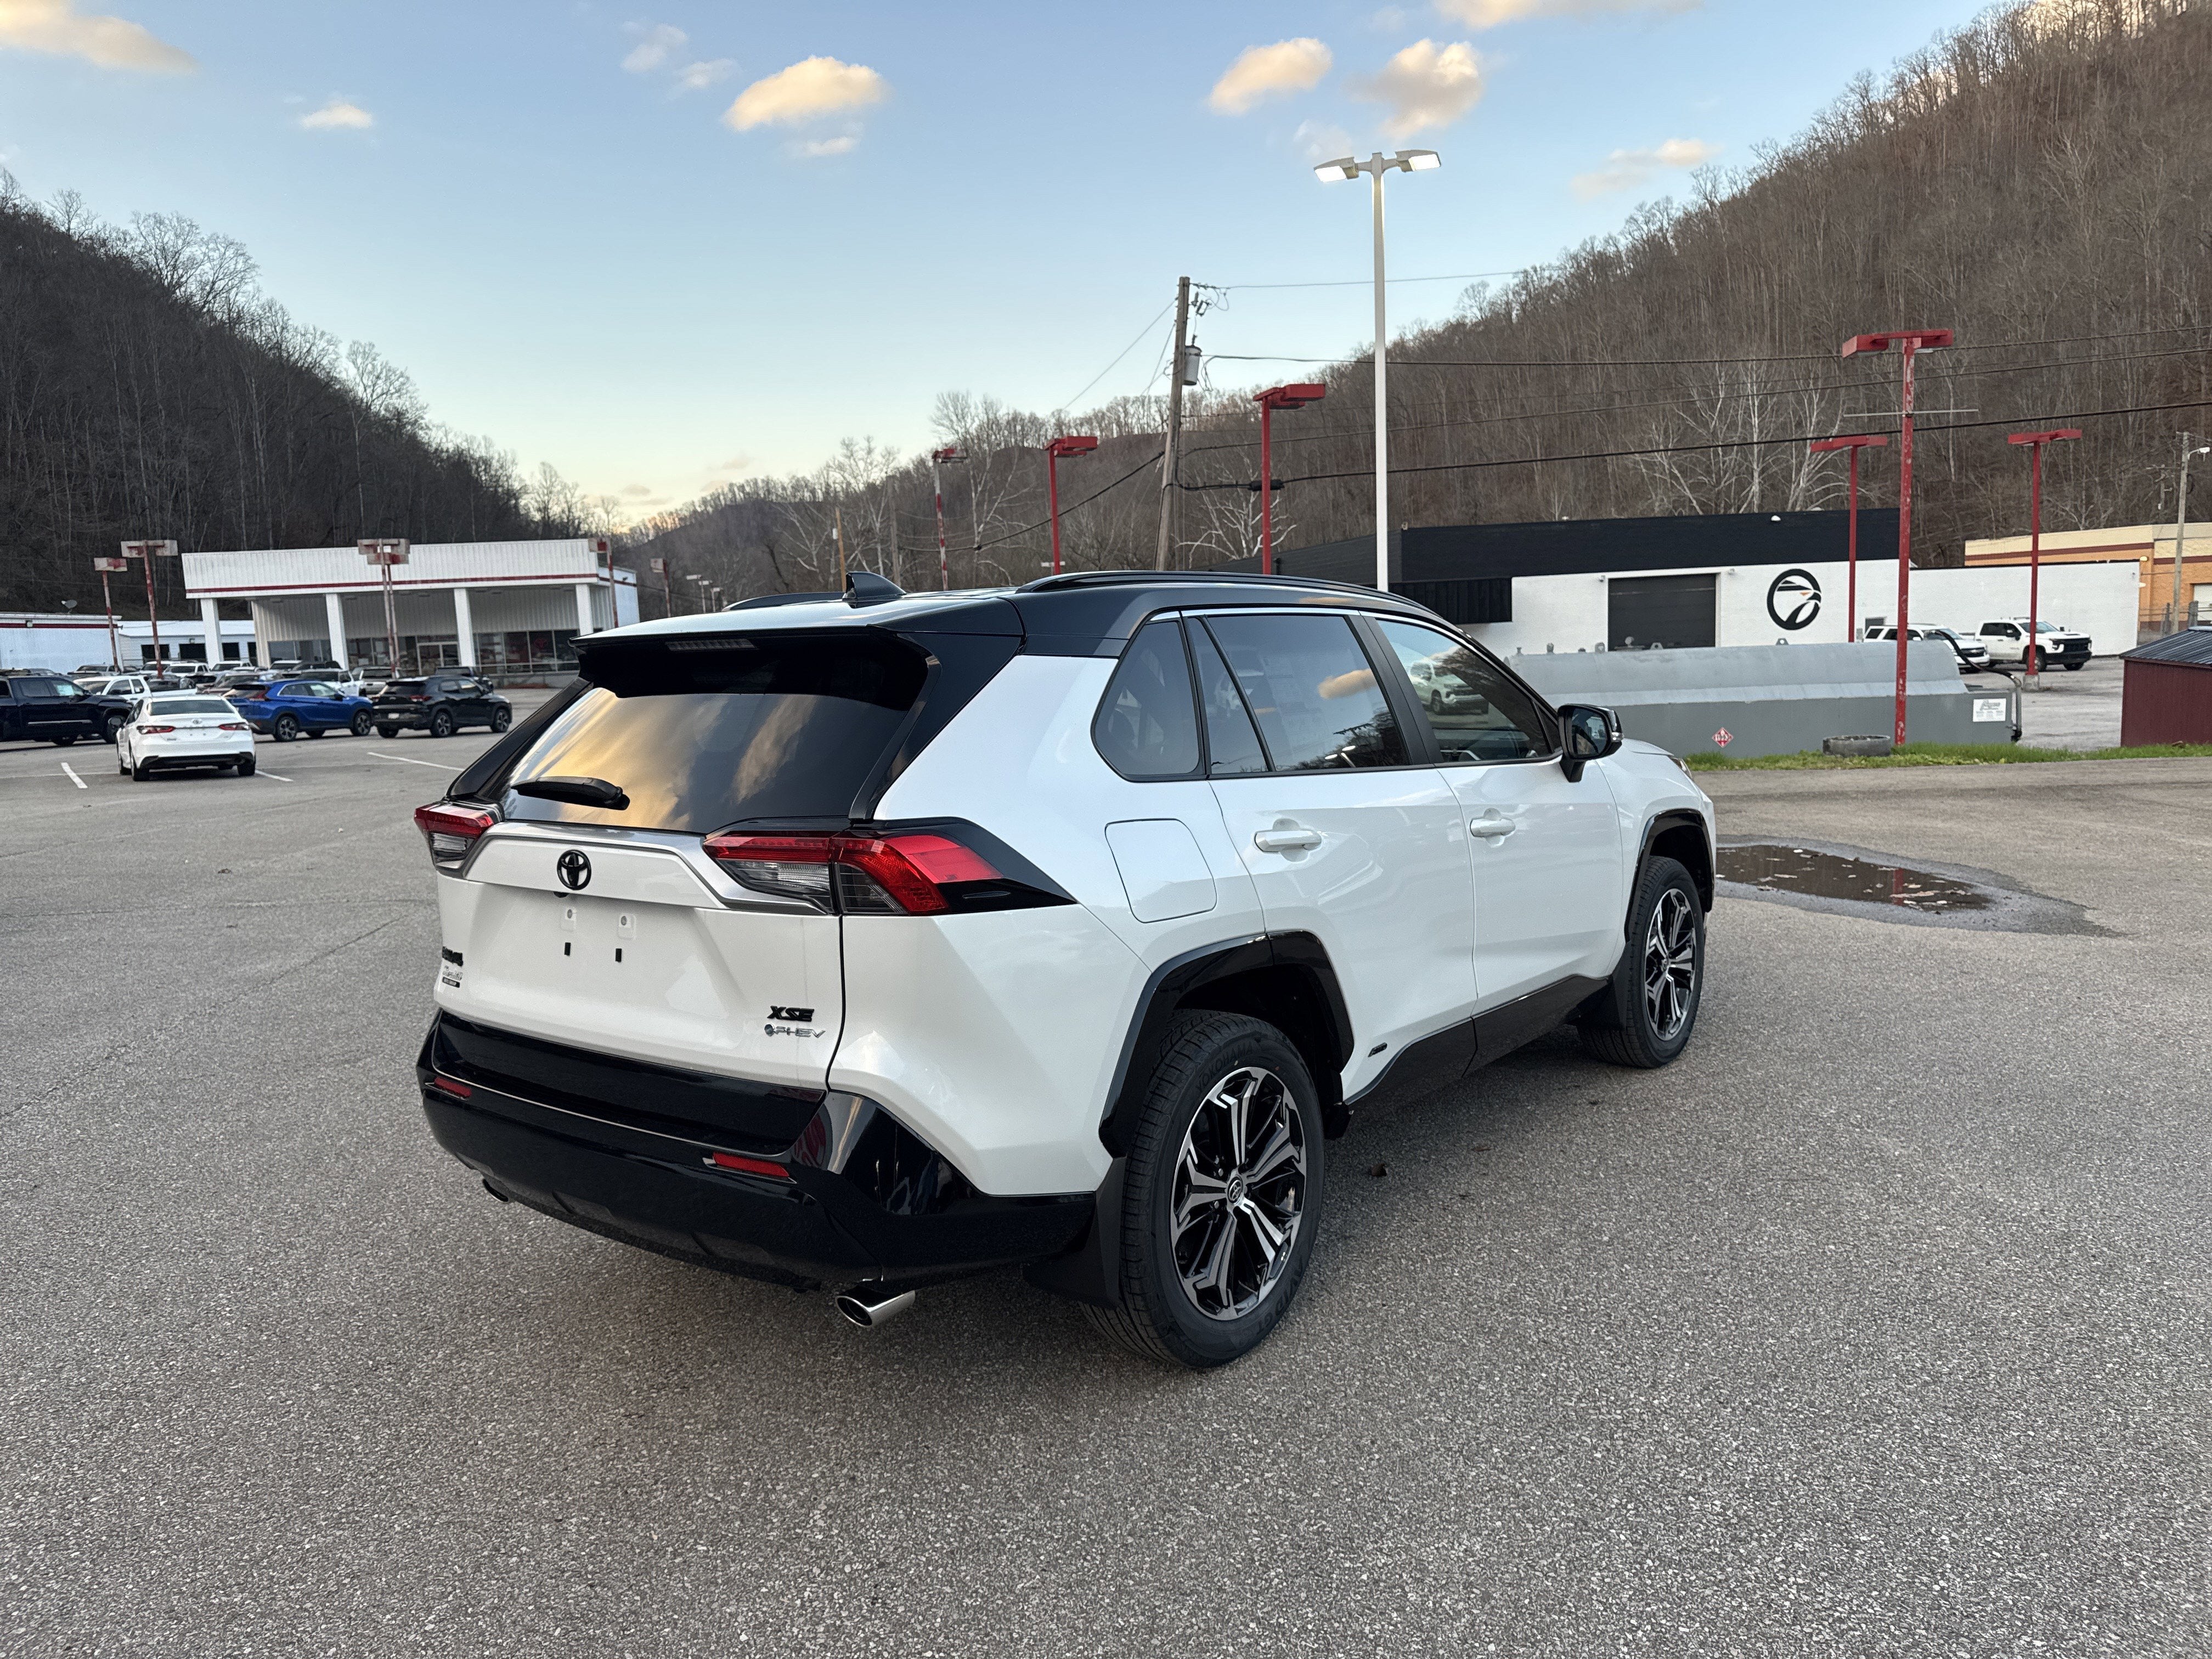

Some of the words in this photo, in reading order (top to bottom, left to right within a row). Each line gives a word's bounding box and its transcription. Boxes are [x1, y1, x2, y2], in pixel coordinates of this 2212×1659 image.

[767, 1006, 814, 1022] XSE
[776, 1026, 826, 1039] PHEV
[1195, 1041, 1252, 1094] YOKOHAMA
